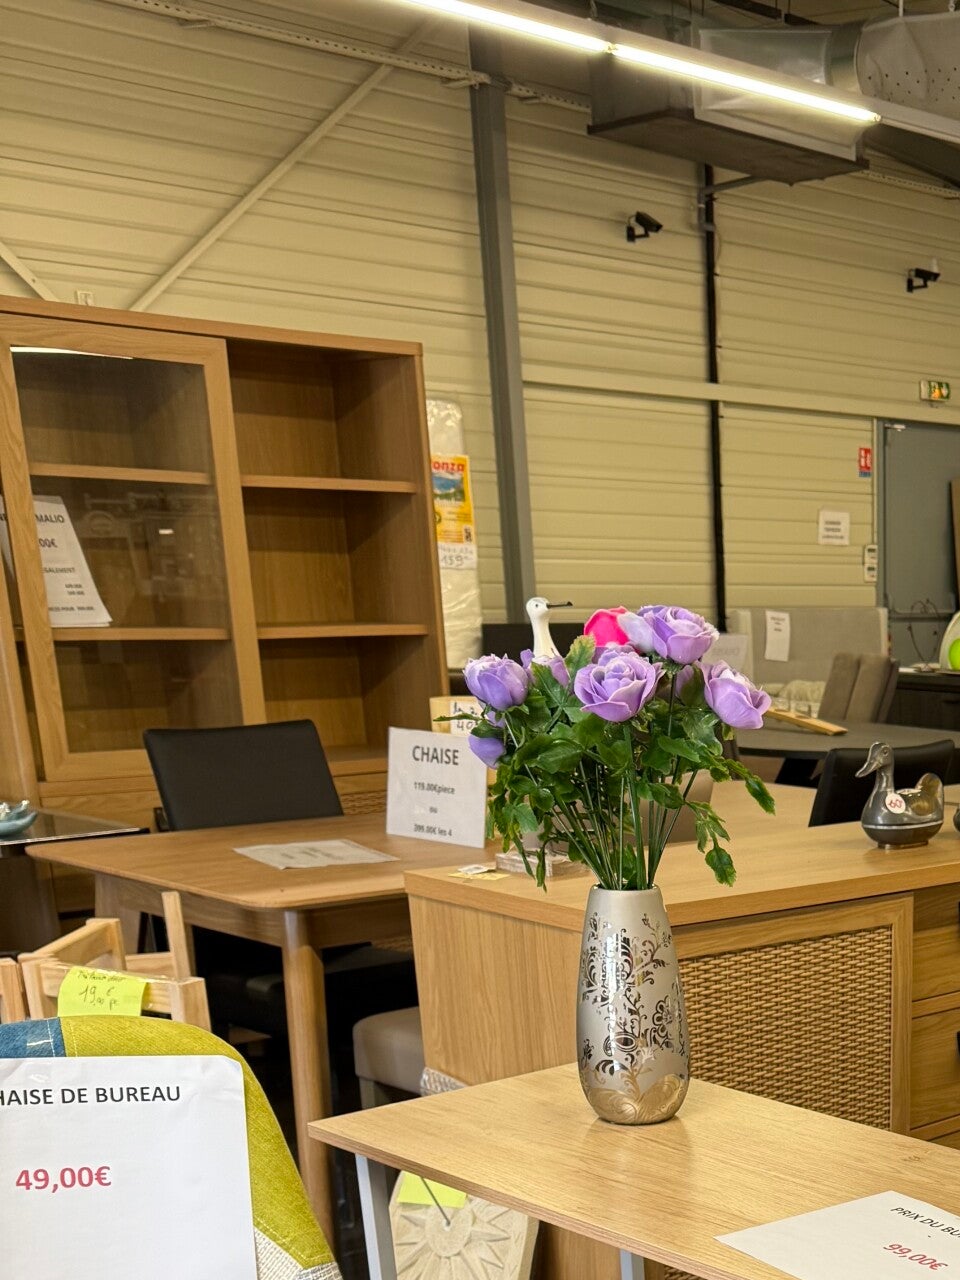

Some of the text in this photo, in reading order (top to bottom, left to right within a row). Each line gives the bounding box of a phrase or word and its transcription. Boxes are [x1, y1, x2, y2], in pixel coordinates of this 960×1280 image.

[412, 745, 460, 766] CHAISE
[60, 1087, 89, 1104] DE
[96, 1085, 181, 1103] BUREAU
[15, 1165, 112, 1194] 49,00€
[890, 1206, 923, 1221] PRIX
[920, 1218, 943, 1230] DU
[883, 1243, 949, 1271] 99,00€
